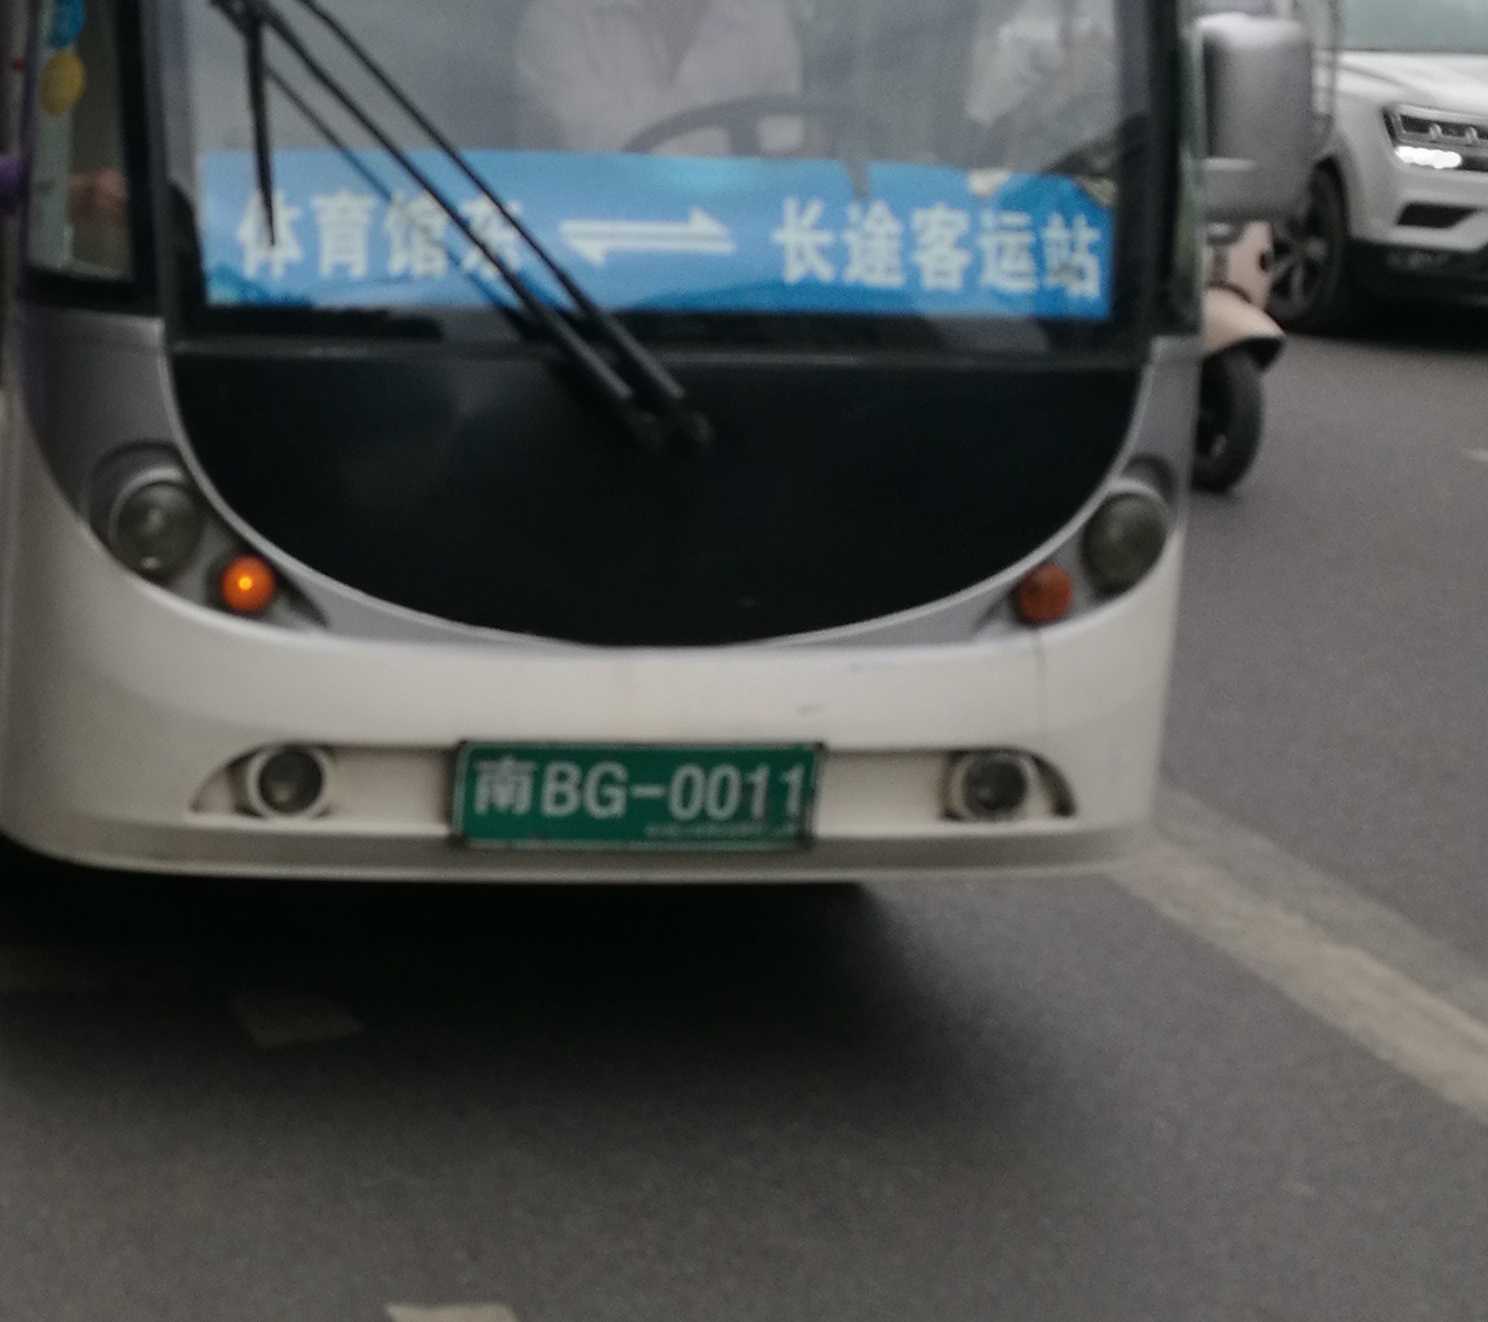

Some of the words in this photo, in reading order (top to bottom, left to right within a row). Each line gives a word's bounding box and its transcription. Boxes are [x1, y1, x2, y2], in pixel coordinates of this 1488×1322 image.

[771, 194, 1104, 298] 长途客运站
[472, 754, 806, 821] 南BG-0011
